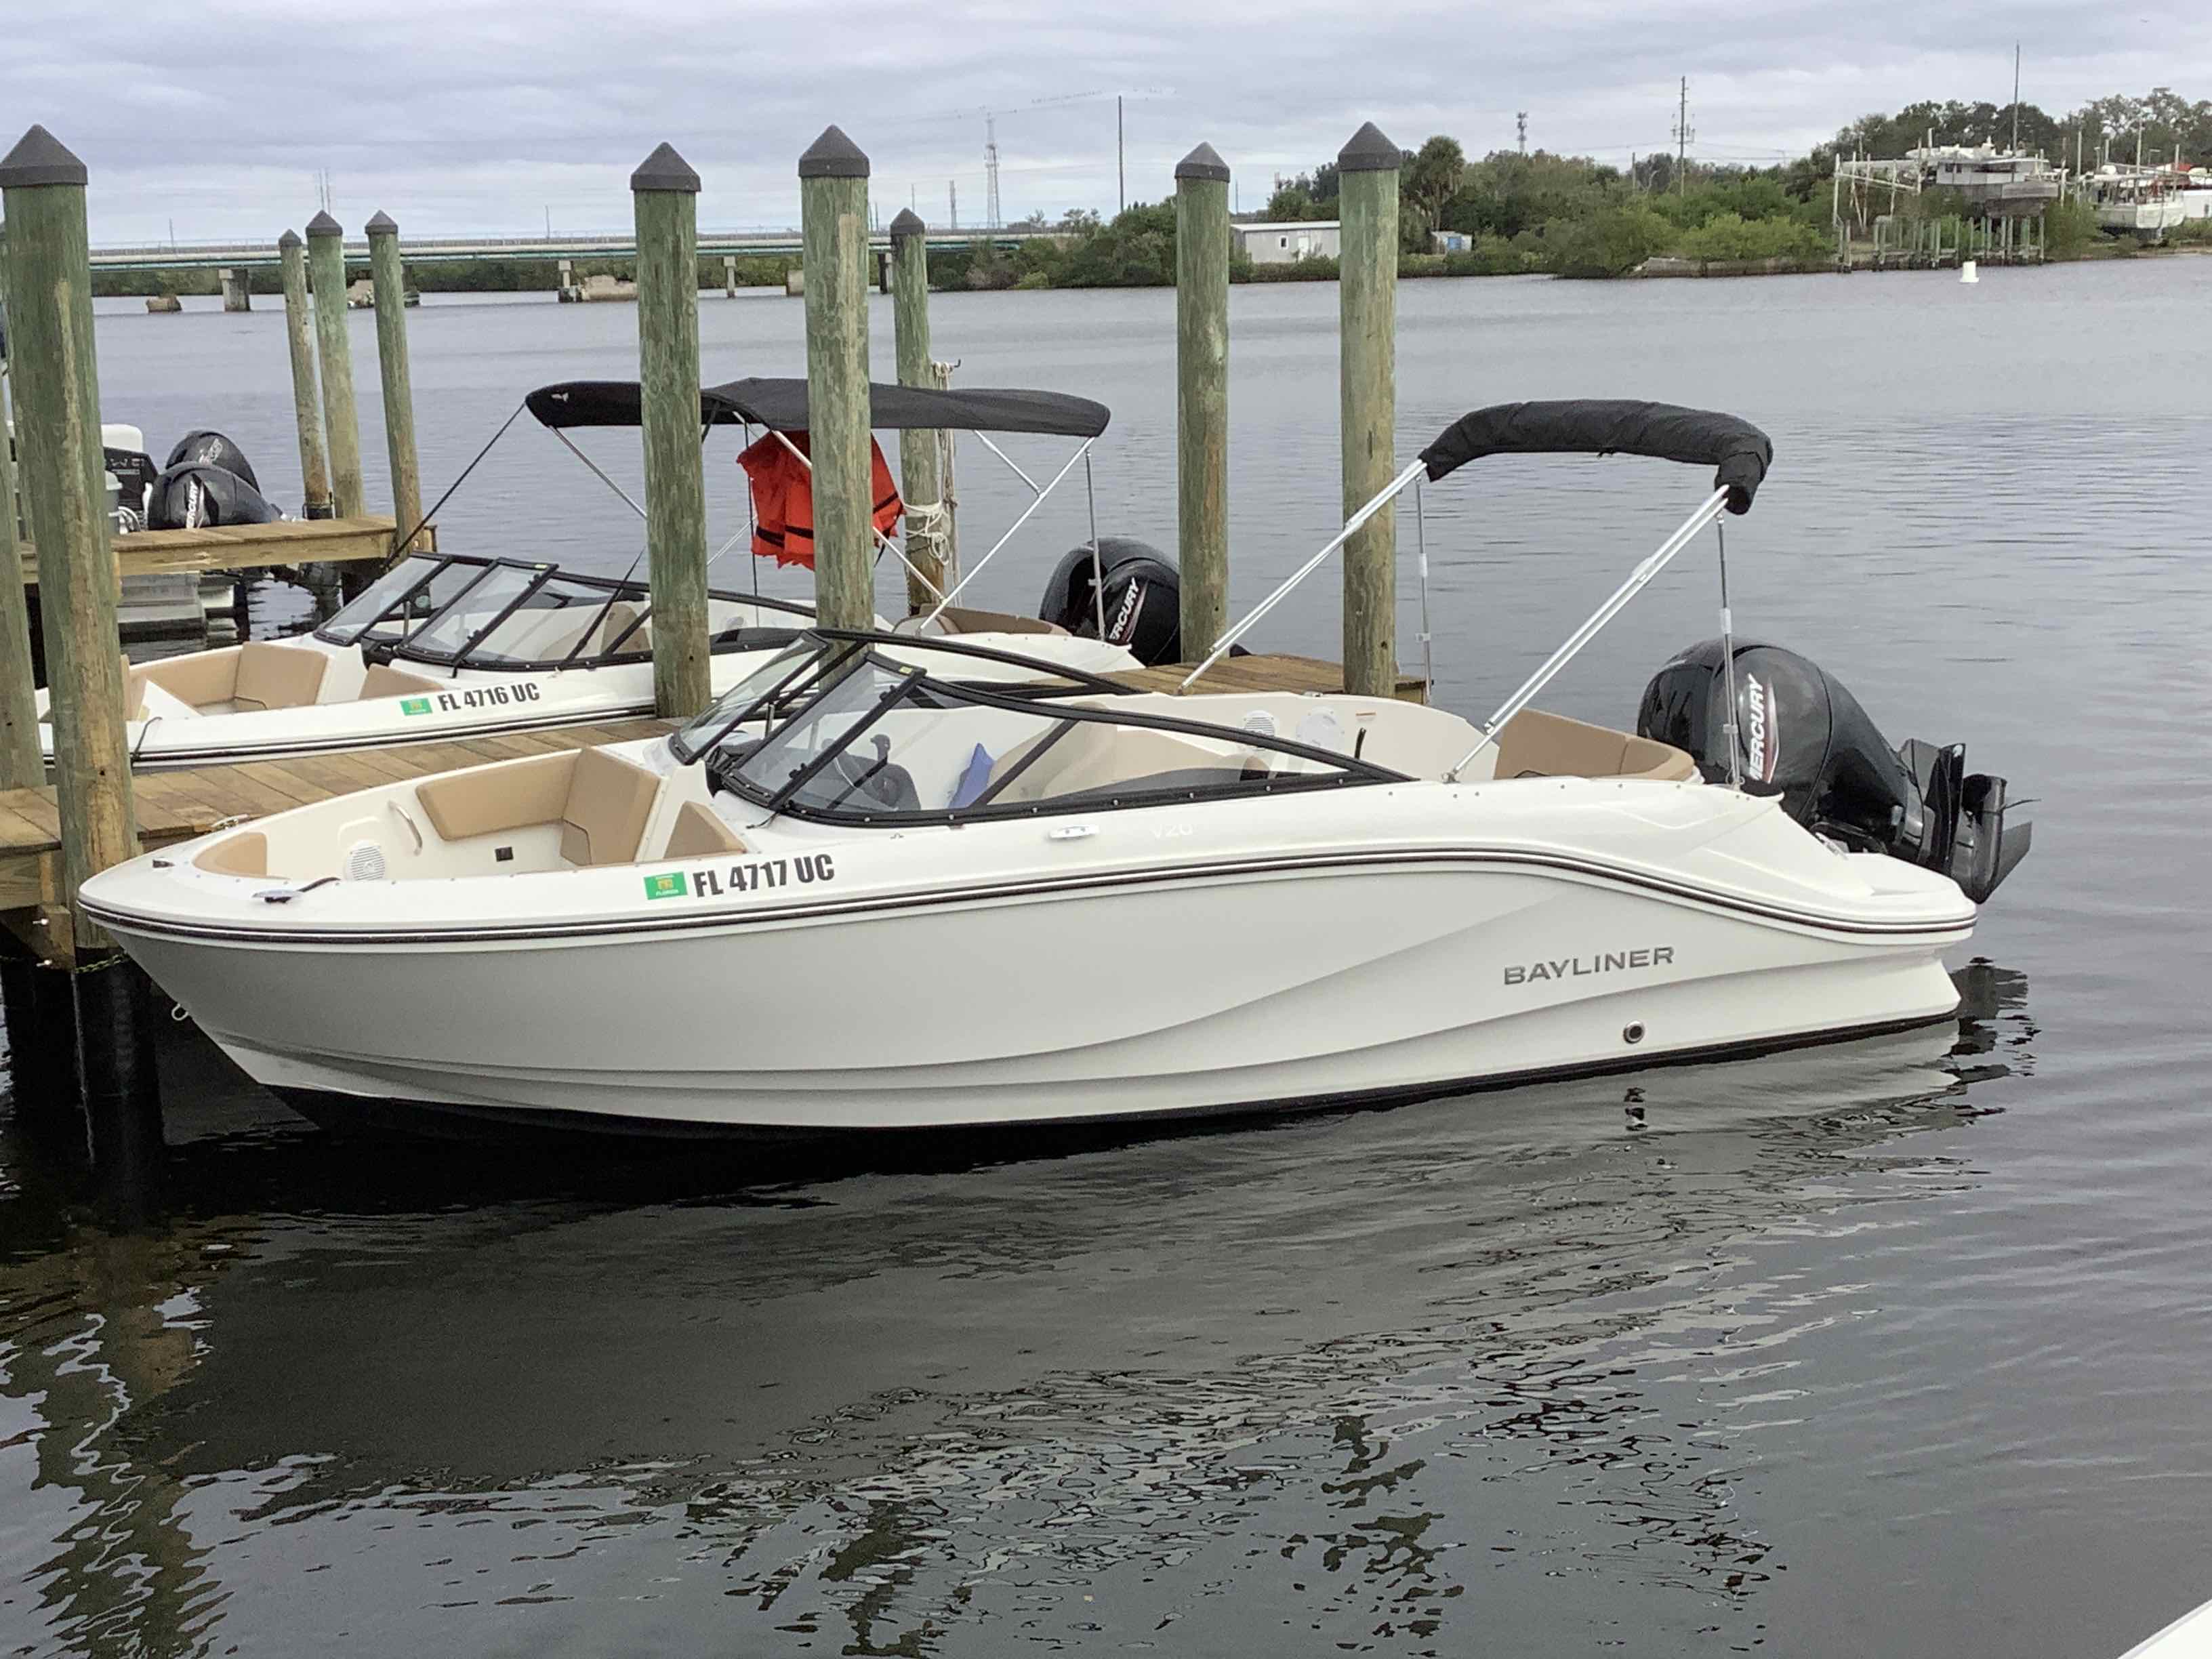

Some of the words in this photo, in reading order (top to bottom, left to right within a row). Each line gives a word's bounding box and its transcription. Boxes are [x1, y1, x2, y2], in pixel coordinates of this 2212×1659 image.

[437, 693, 462, 712] FL
[464, 687, 509, 708] 4716
[510, 682, 540, 703] UC
[692, 870, 724, 898] FL
[729, 859, 787, 891] 4717
[794, 853, 835, 883] UC
[1504, 946, 1675, 985] BAYLINER
